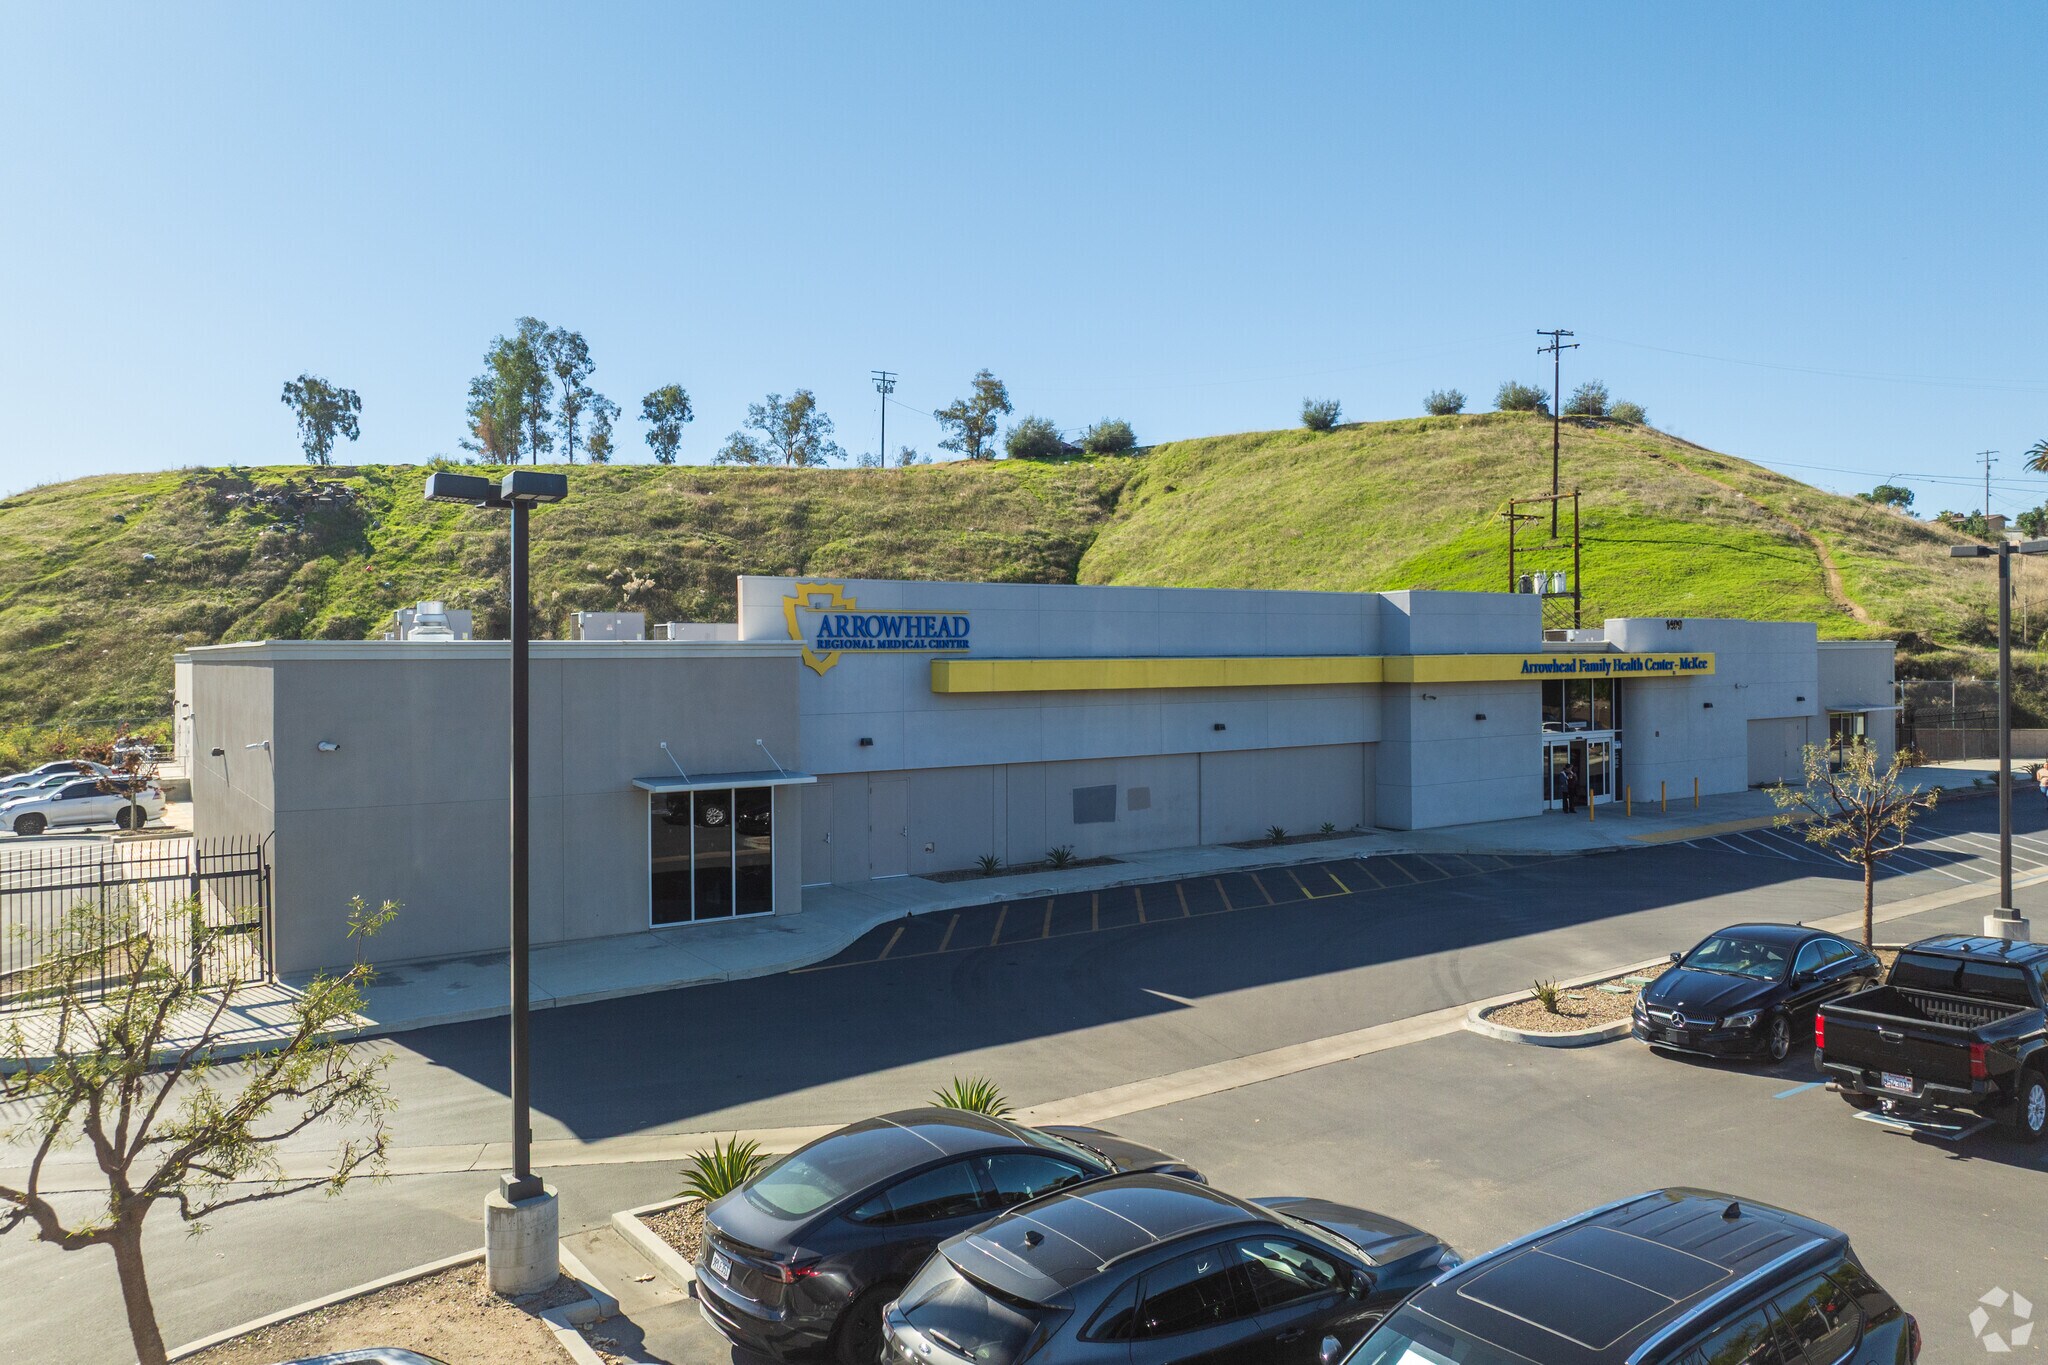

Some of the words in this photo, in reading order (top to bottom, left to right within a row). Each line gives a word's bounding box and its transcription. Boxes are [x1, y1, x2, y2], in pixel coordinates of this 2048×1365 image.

[817, 614, 970, 638] ARROWHEAD
[817, 639, 875, 649] REGIONAL
[877, 640, 927, 649] MEDICAL
[929, 640, 970, 649] CENTER
[1521, 658, 1577, 674] Arrowhead
[1579, 657, 1612, 676] Family
[1613, 657, 1644, 671] Health
